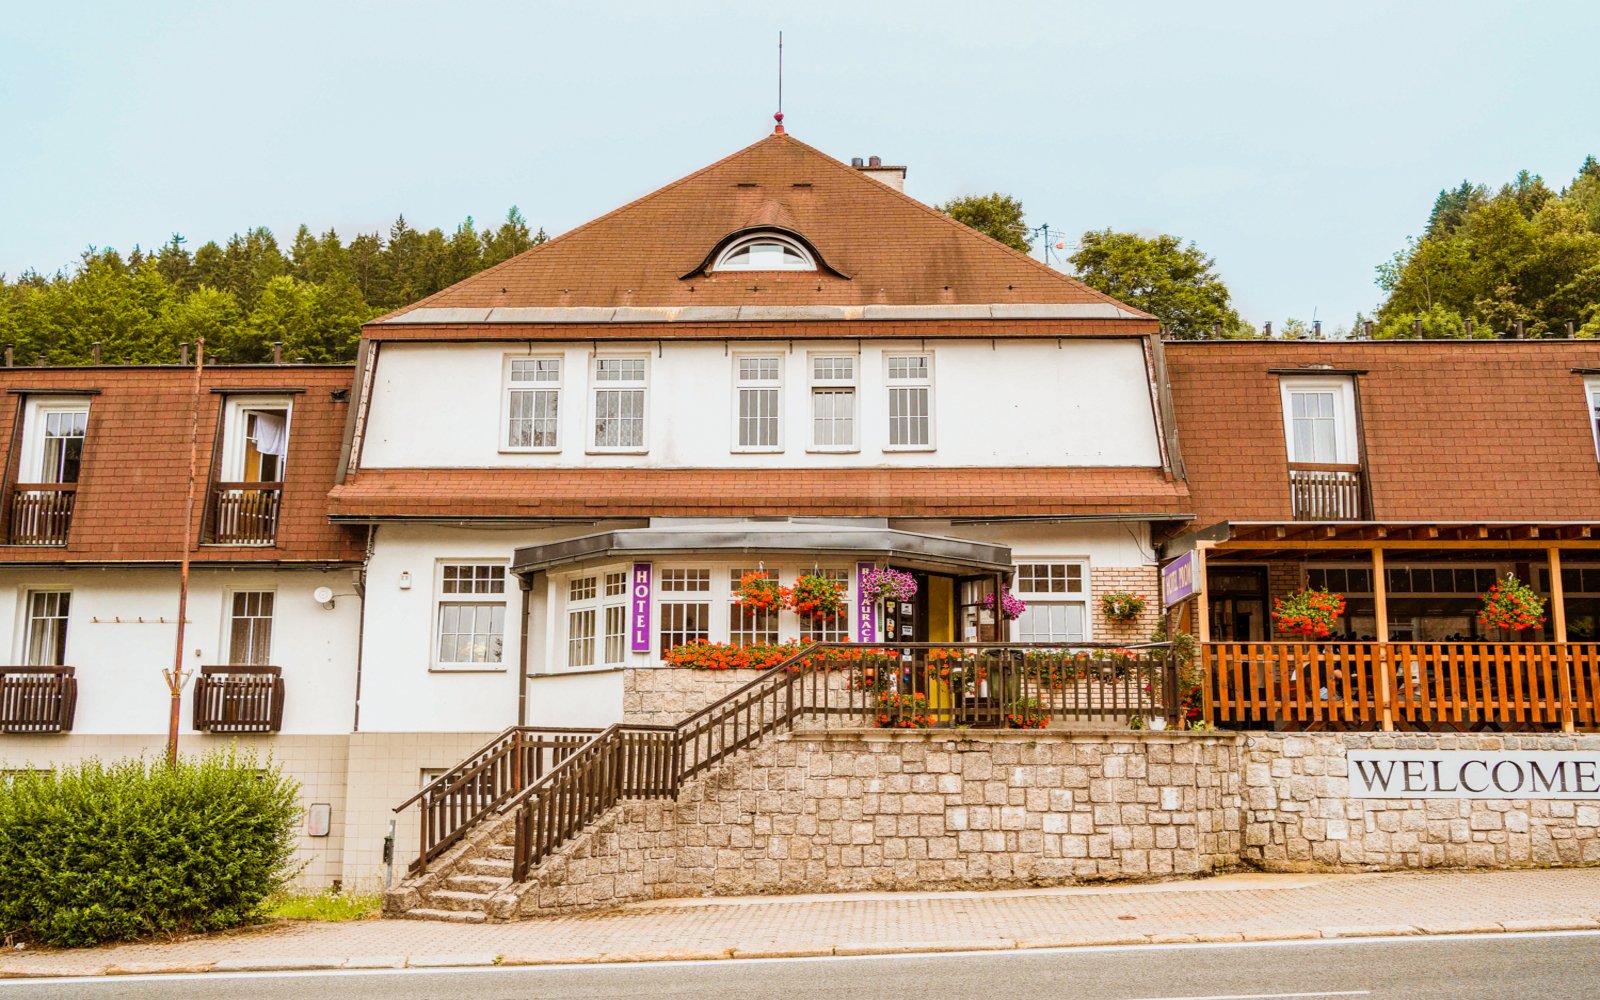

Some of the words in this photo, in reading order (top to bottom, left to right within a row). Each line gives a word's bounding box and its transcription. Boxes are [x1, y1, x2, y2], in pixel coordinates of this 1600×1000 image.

[635, 570, 649, 643] HOTEL
[861, 567, 872, 643] RTAURACE
[1353, 760, 1600, 793] WELCOME
